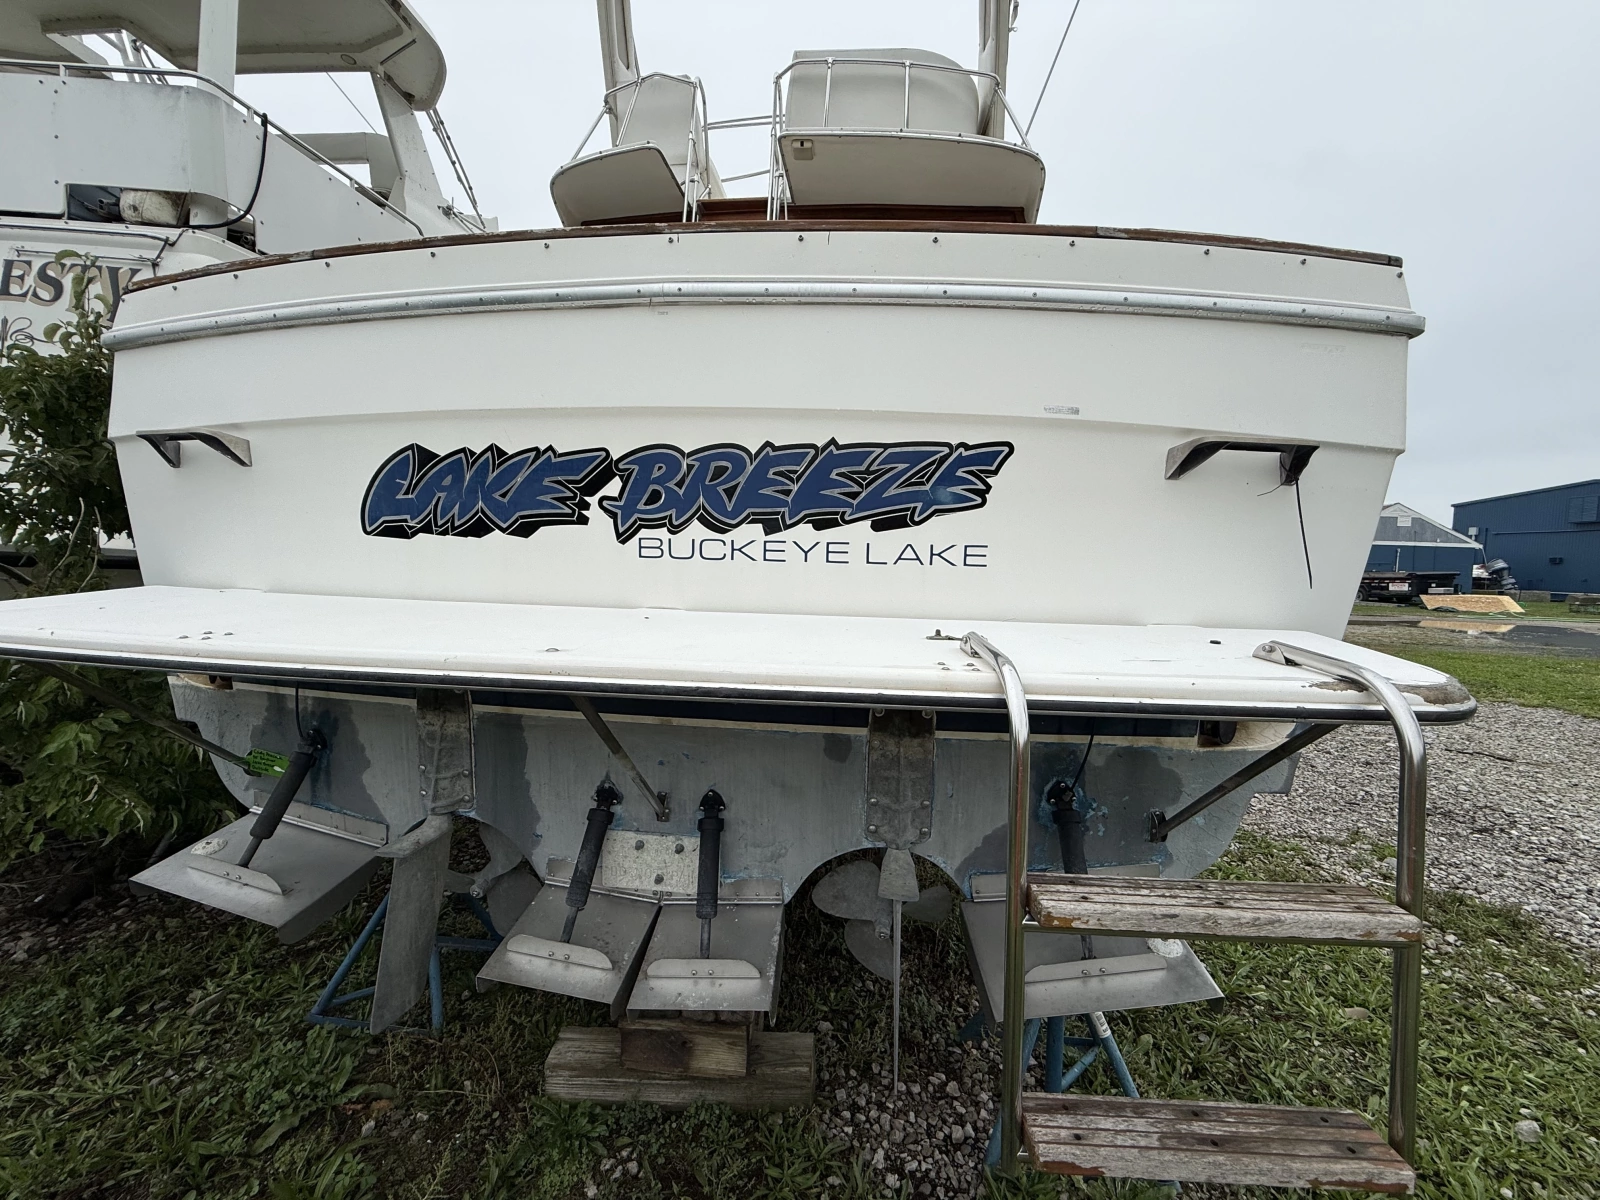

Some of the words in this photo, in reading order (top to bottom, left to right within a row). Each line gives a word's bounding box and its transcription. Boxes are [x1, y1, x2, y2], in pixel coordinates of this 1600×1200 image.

[360, 442, 615, 540] LAKE
[598, 436, 1014, 545] BREEZE
[637, 537, 850, 564] BUCKEYE
[865, 541, 989, 568] LAKE
